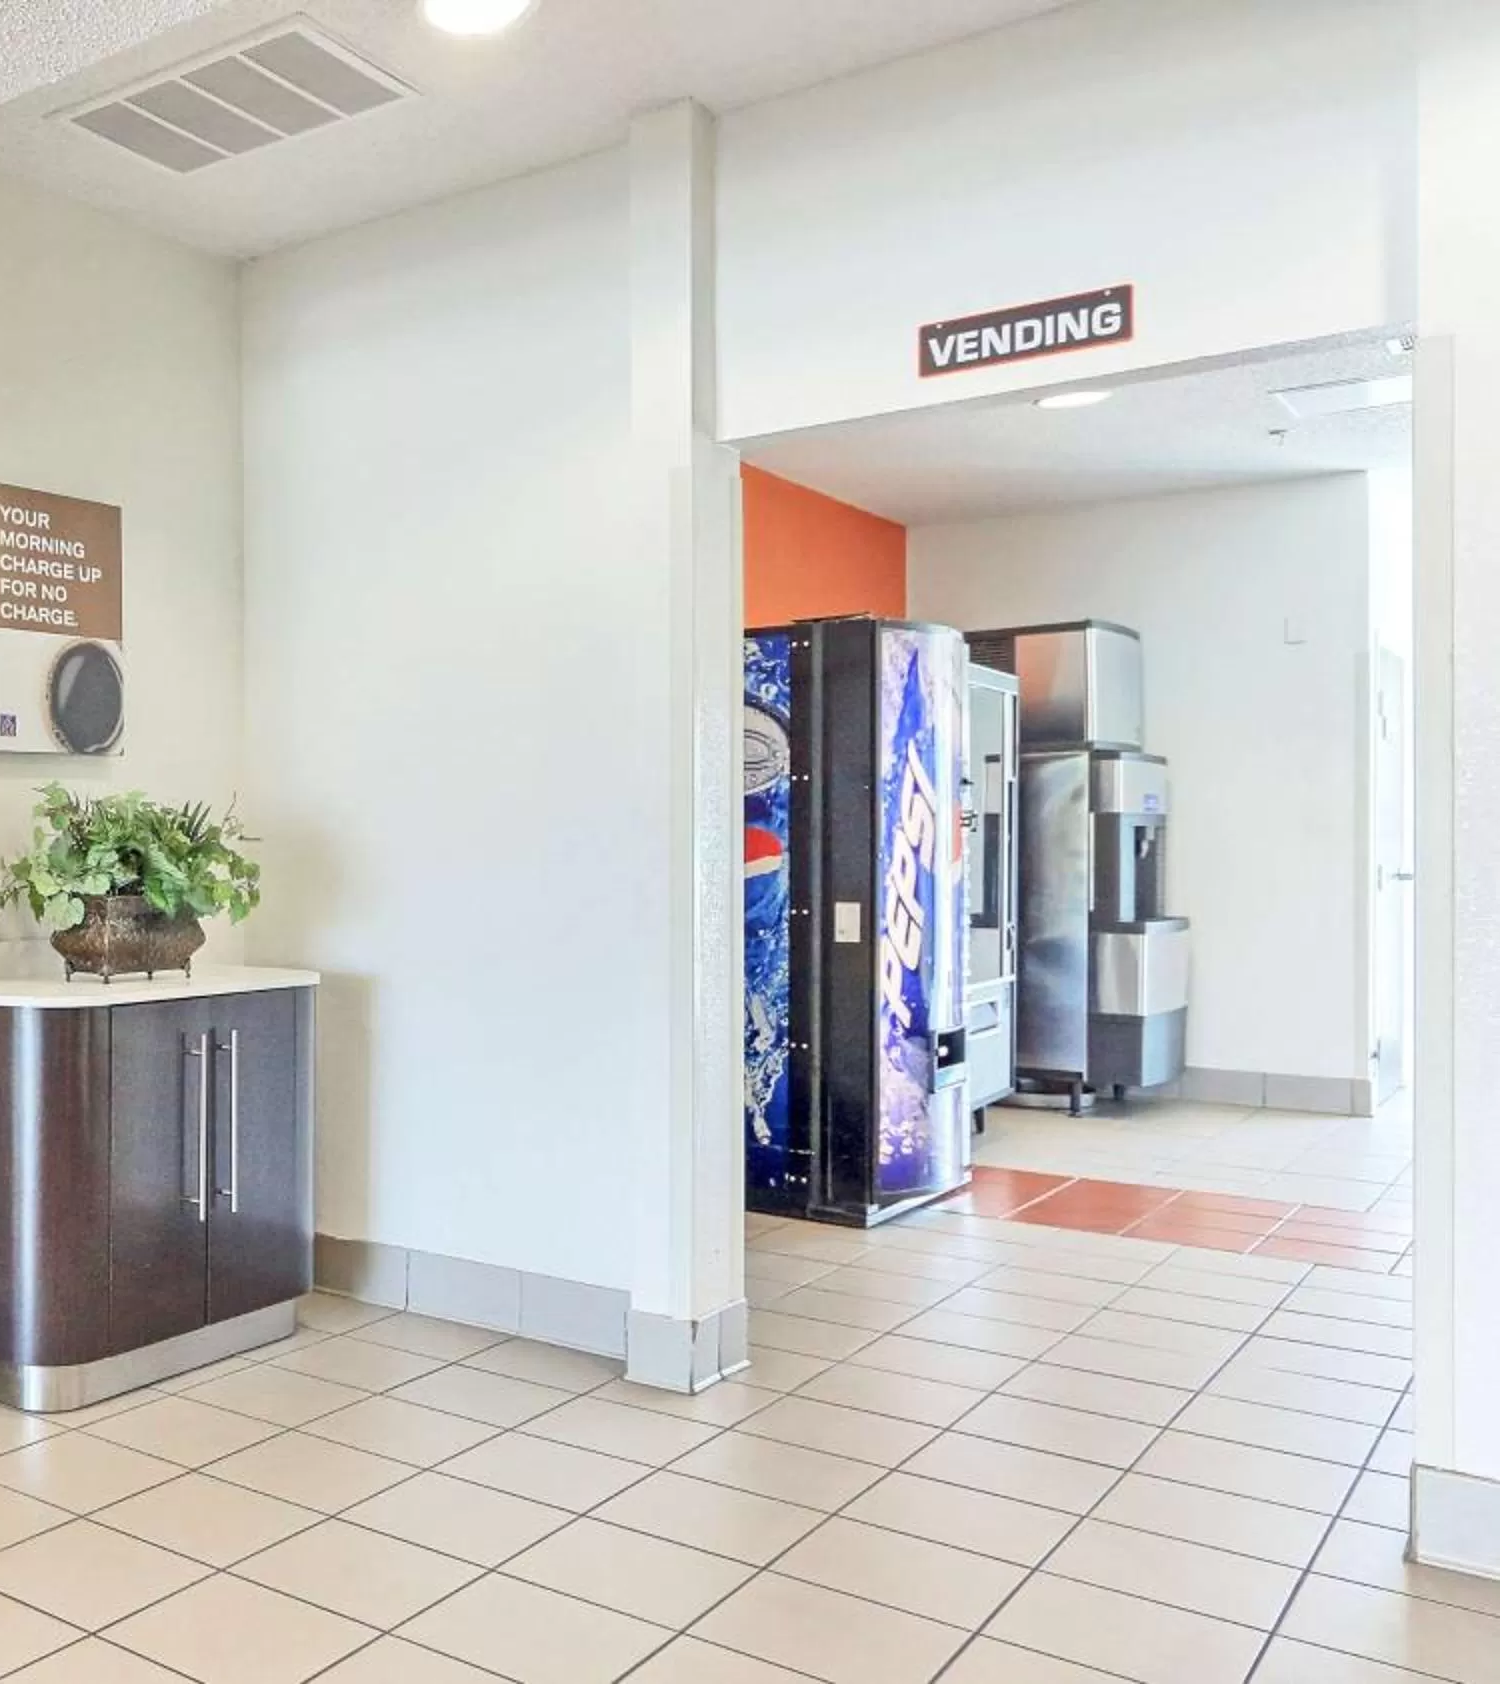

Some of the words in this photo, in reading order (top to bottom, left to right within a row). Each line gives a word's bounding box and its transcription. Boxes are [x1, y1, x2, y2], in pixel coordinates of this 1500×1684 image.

[928, 303, 1122, 367] VENDING
[0, 505, 50, 529] YOUR
[0, 530, 84, 559] MORNING
[0, 554, 74, 580] CHARGE
[79, 564, 102, 583] UP
[0, 578, 37, 598] FOR
[41, 584, 67, 602] NO
[0, 602, 78, 626] CHARGE.
[881, 738, 936, 1029] PEPSI
